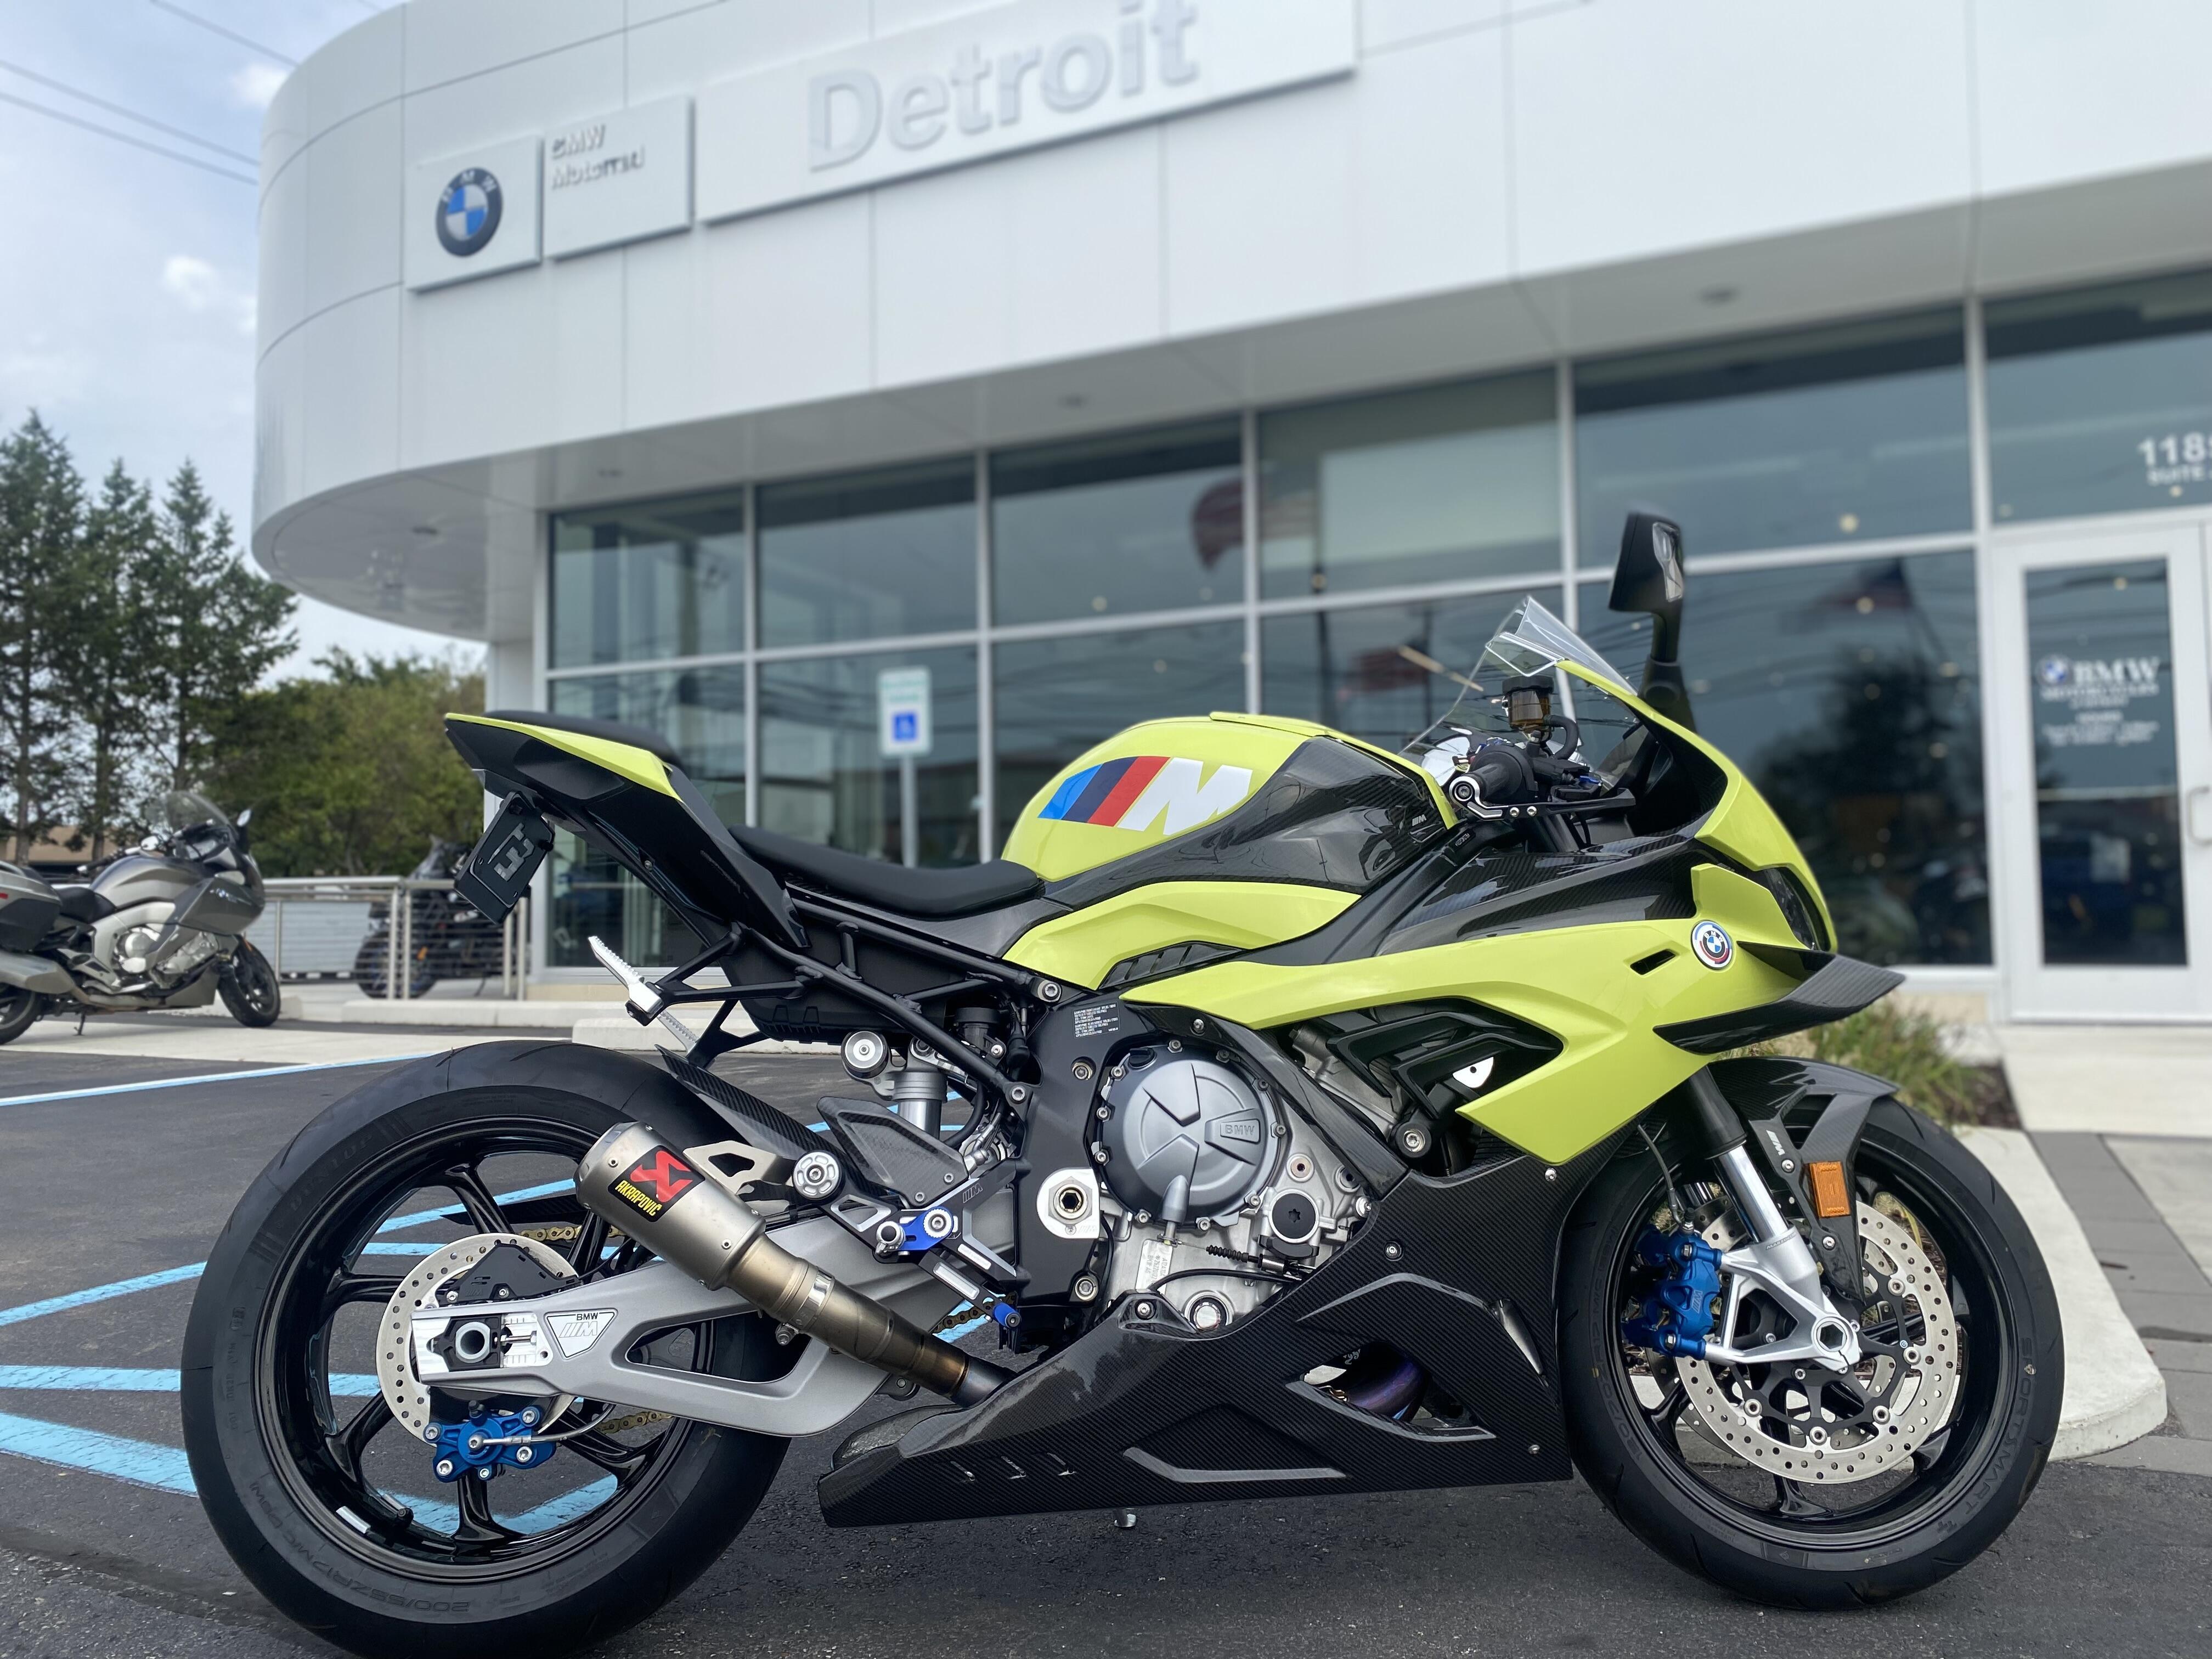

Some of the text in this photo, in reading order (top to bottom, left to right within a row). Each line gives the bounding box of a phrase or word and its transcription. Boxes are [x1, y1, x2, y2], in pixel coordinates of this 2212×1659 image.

[809, 0, 1200, 173] Detroit
[442, 170, 498, 204] BMW
[2136, 431, 2212, 466] 118
[2074, 657, 2160, 687] BMW
[1703, 930, 1724, 943] BMW
[1225, 1124, 1255, 1135] BMW
[577, 1312, 598, 1321] BMW
